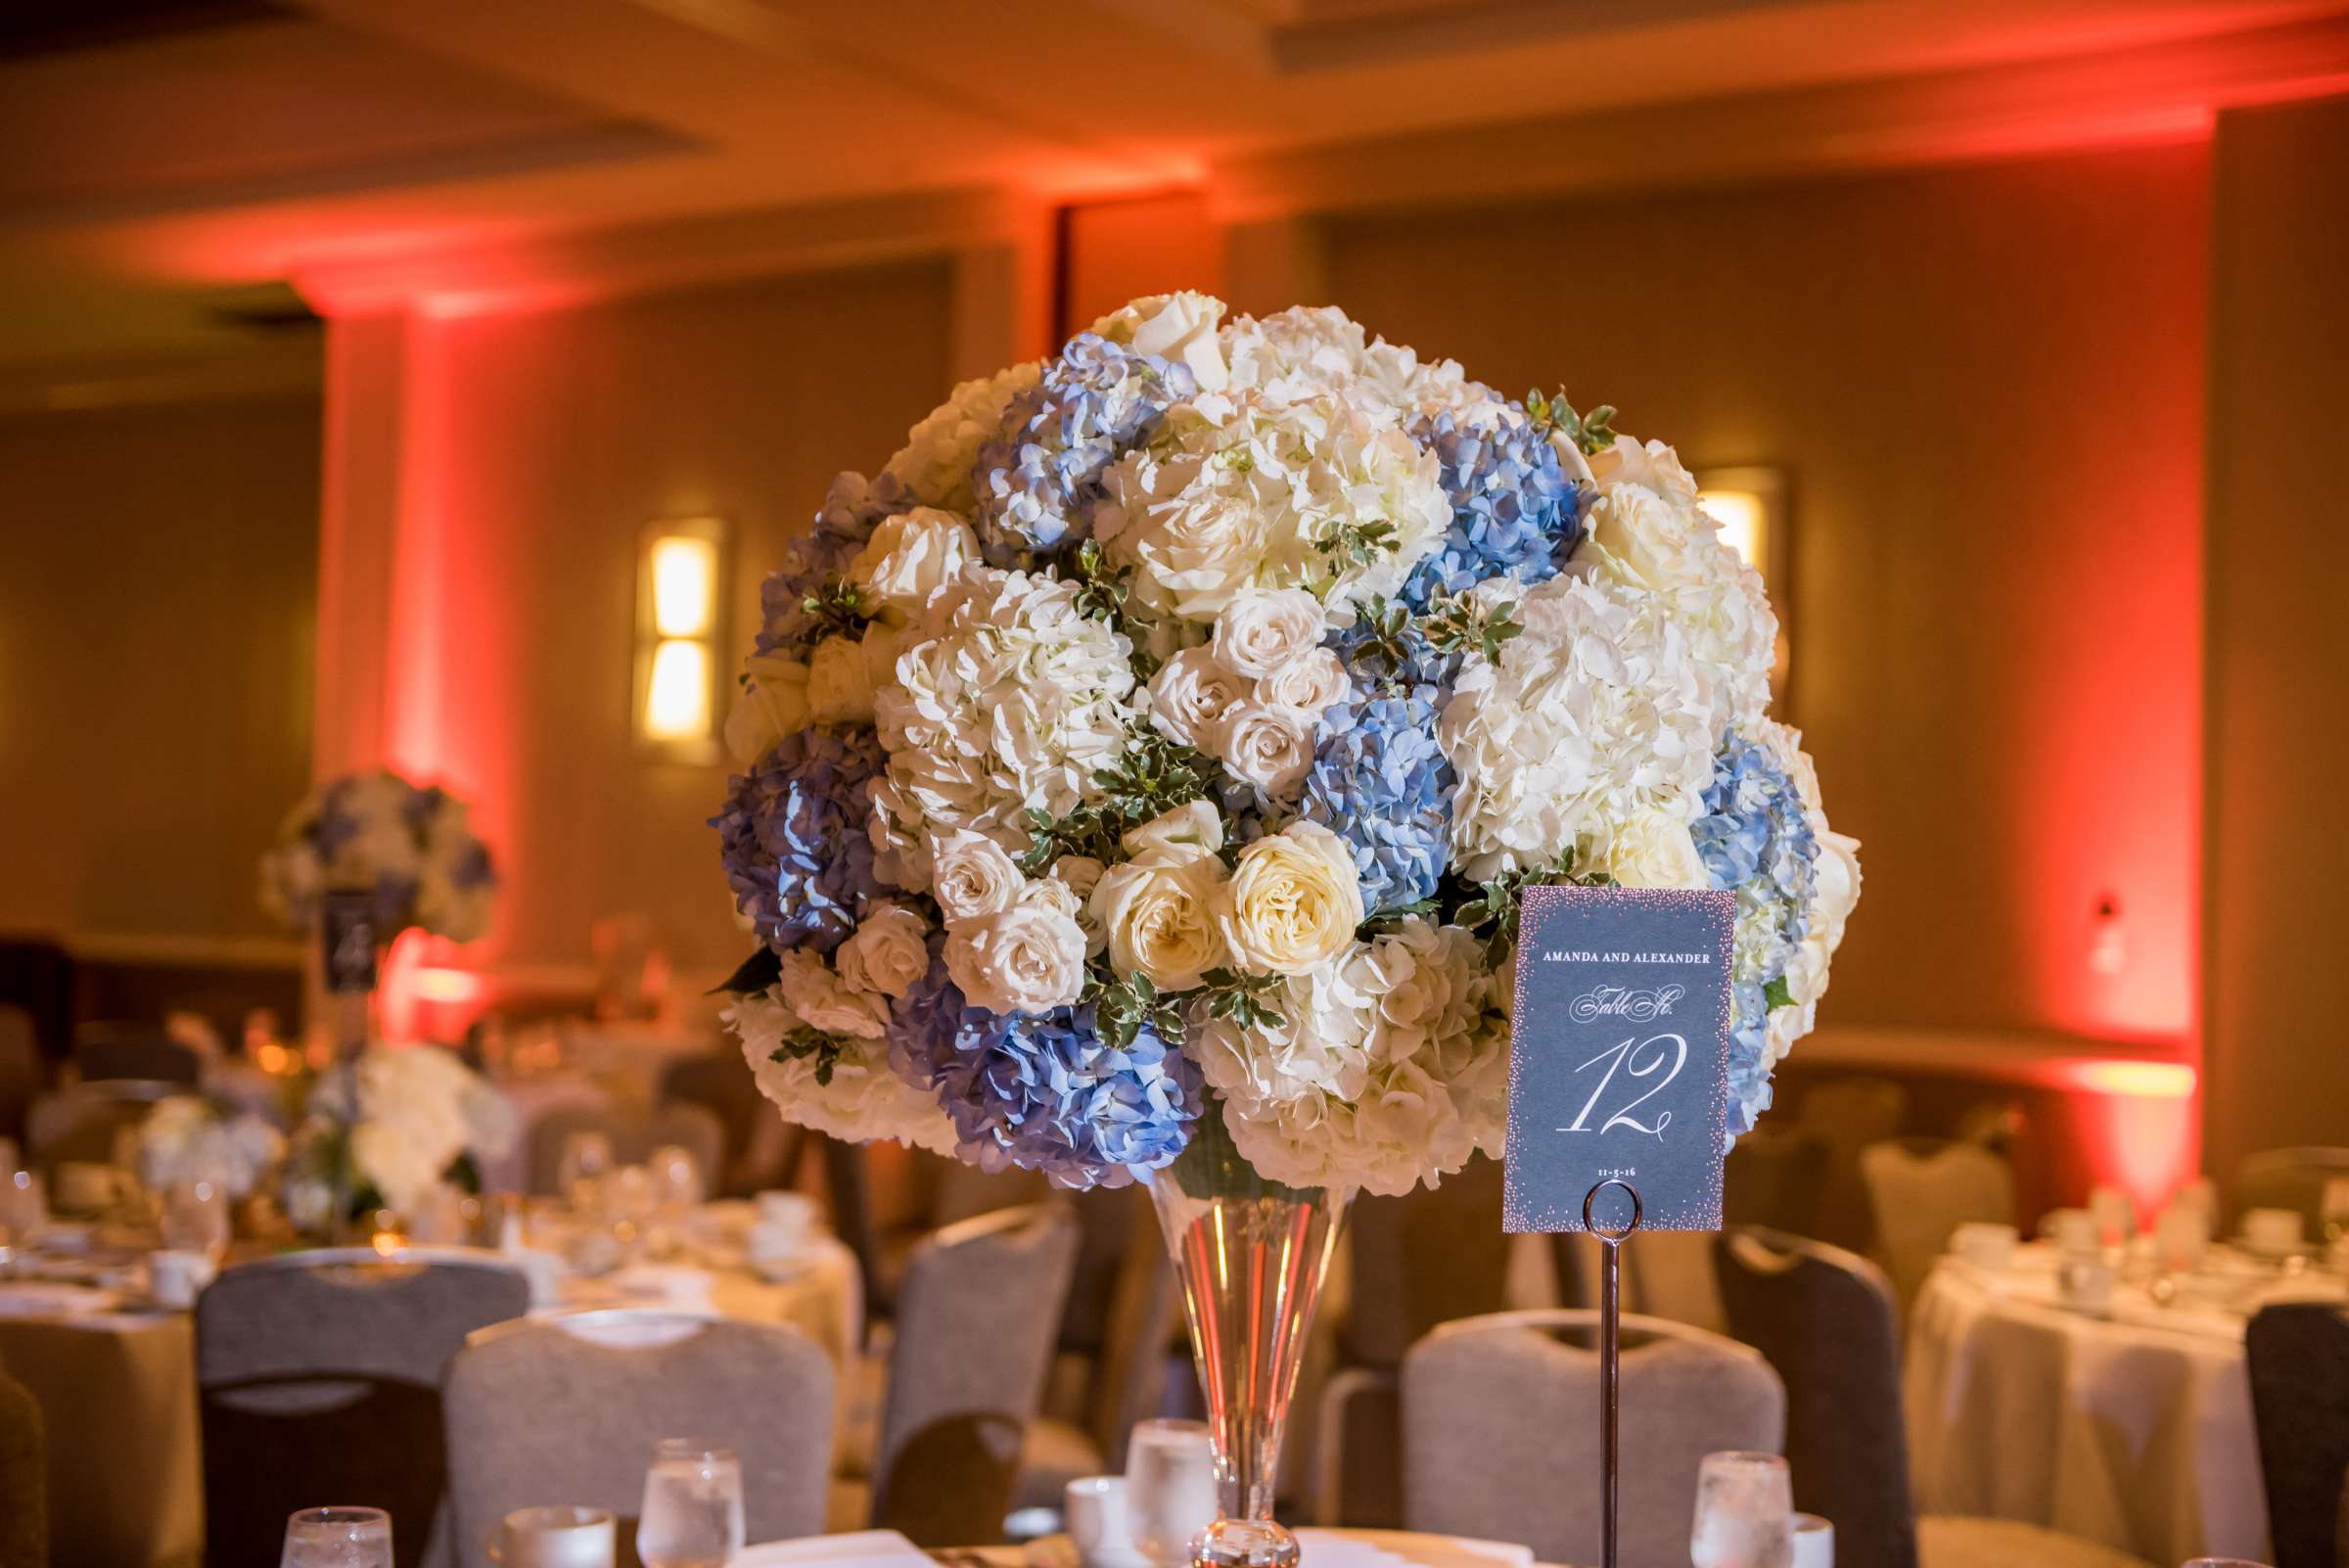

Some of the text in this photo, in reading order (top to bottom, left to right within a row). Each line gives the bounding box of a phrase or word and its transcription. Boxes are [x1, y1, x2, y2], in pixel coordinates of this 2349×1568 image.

[1543, 950, 1711, 964] AMANDA AND ALEXANDER
[1569, 983, 1685, 1024] Table No.
[1555, 1033, 1687, 1142] 12
[1597, 1167, 1636, 1177] 11-5-16
